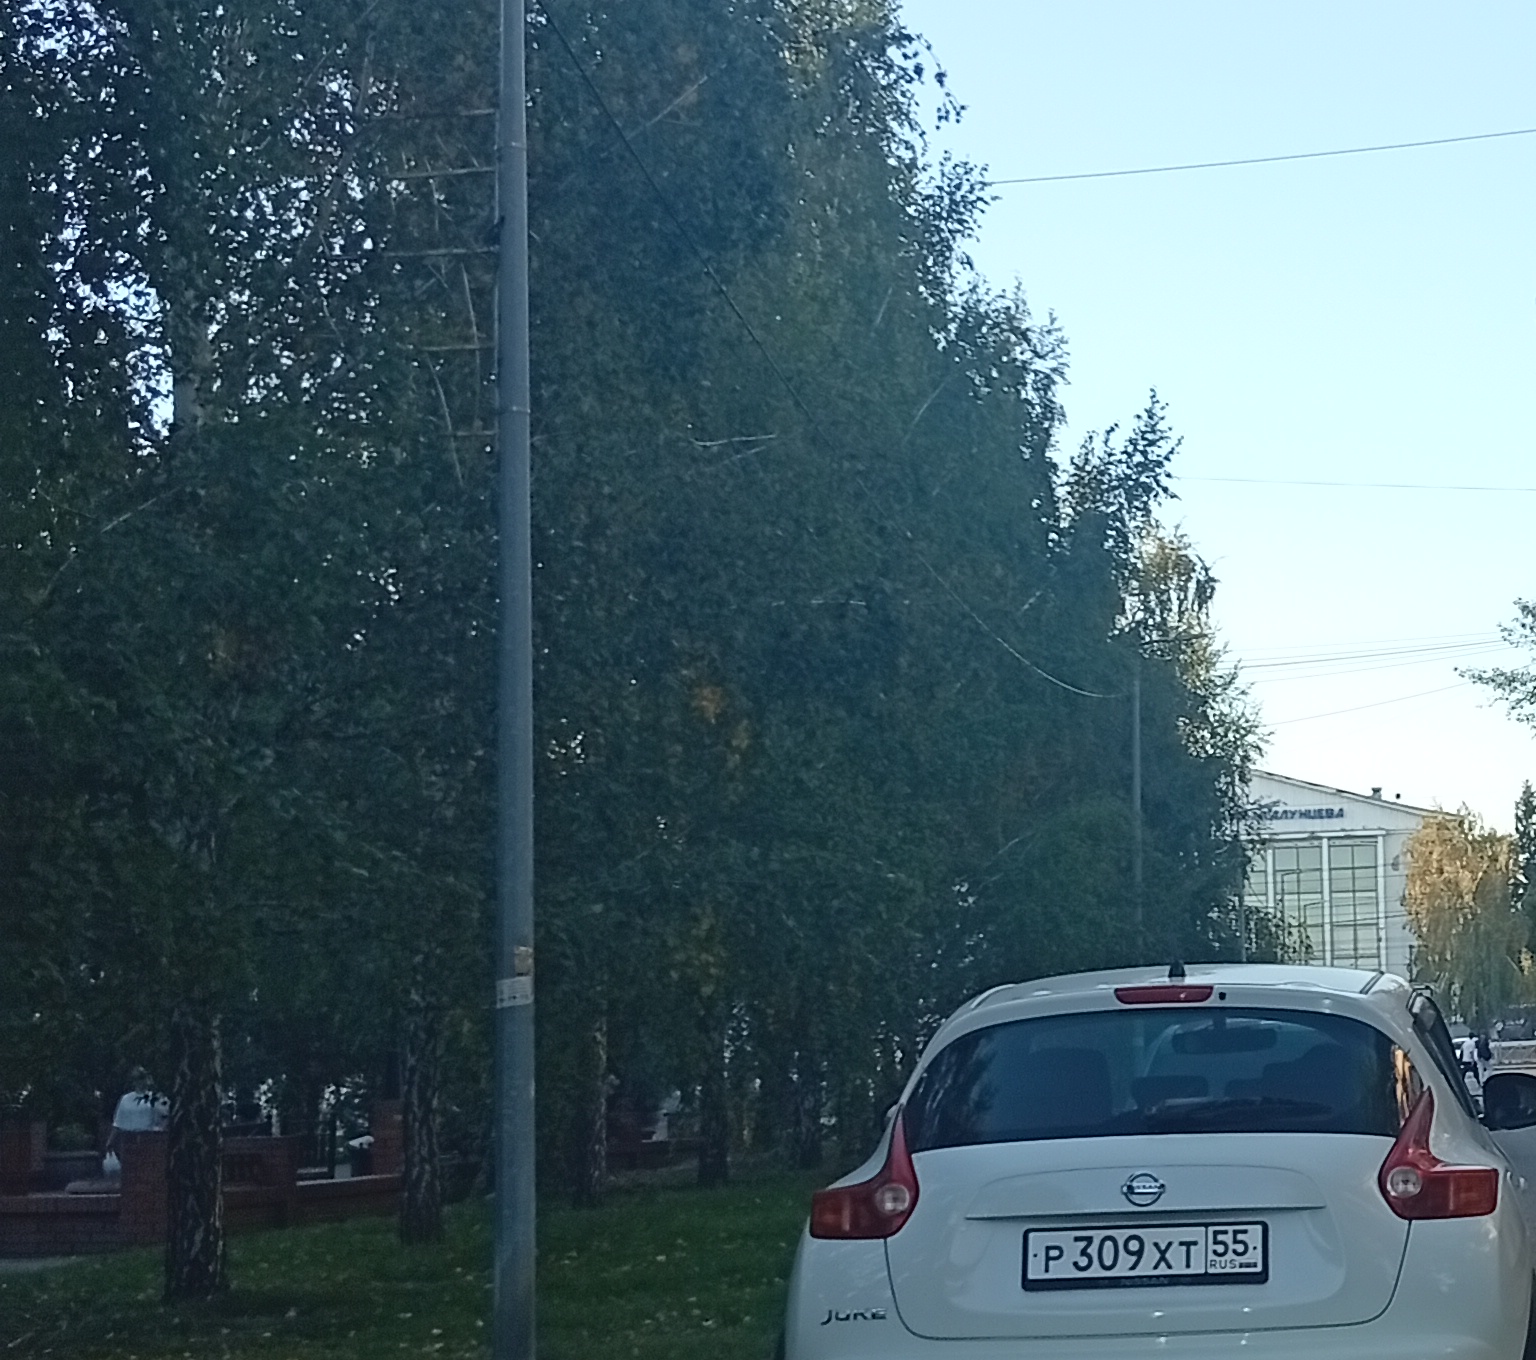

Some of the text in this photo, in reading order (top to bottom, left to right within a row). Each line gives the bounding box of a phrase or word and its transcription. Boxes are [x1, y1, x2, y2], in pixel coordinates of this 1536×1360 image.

[1259, 808, 1344, 820] АЛУНЦЕВА
[1212, 1229, 1249, 1257] 55
[1209, 1259, 1237, 1269] RUS
